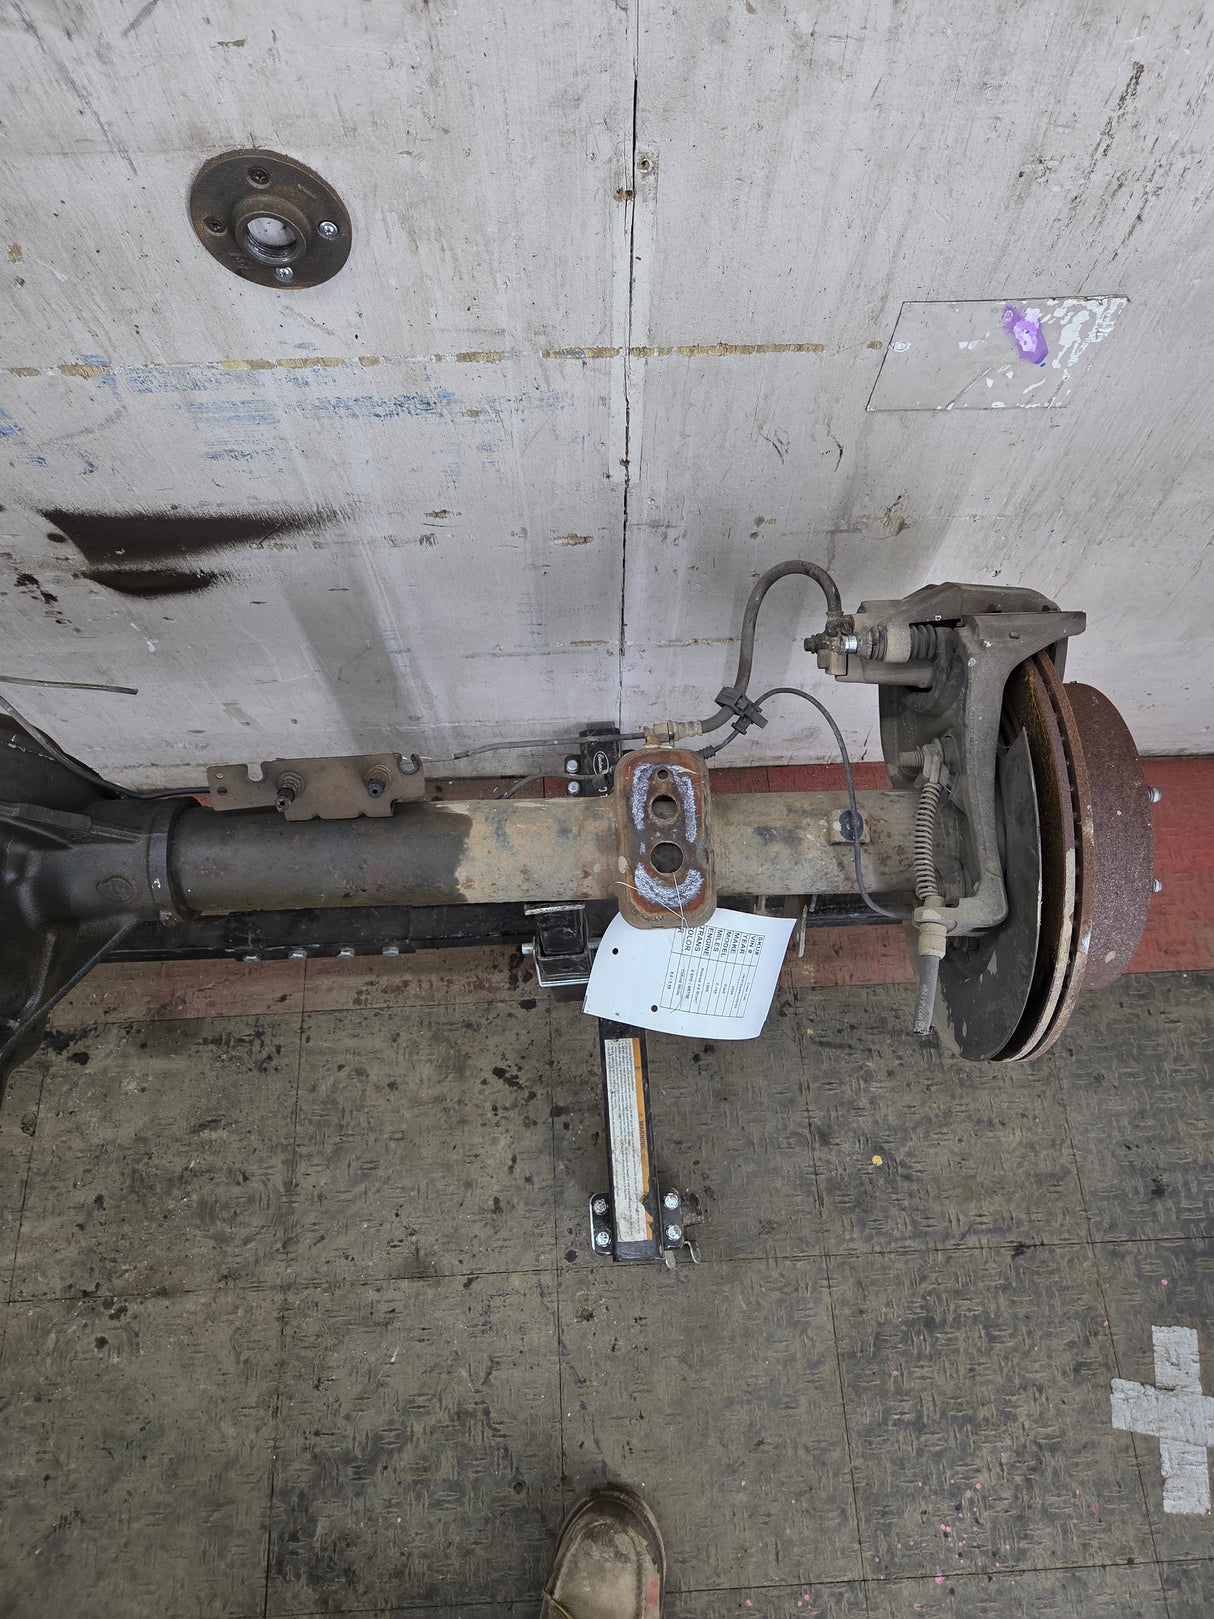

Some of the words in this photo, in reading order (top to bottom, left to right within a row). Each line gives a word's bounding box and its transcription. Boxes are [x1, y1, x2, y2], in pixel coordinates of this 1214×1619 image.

[684, 927, 694, 951] OLOR
[695, 926, 704, 951] TRANS
[703, 927, 712, 956] ENGINE
[713, 929, 723, 952] MILES
[721, 930, 730, 957] MODEL
[731, 932, 739, 954] MAKE
[739, 933, 748, 954] YEAR
[754, 936, 762, 955] SKU#
